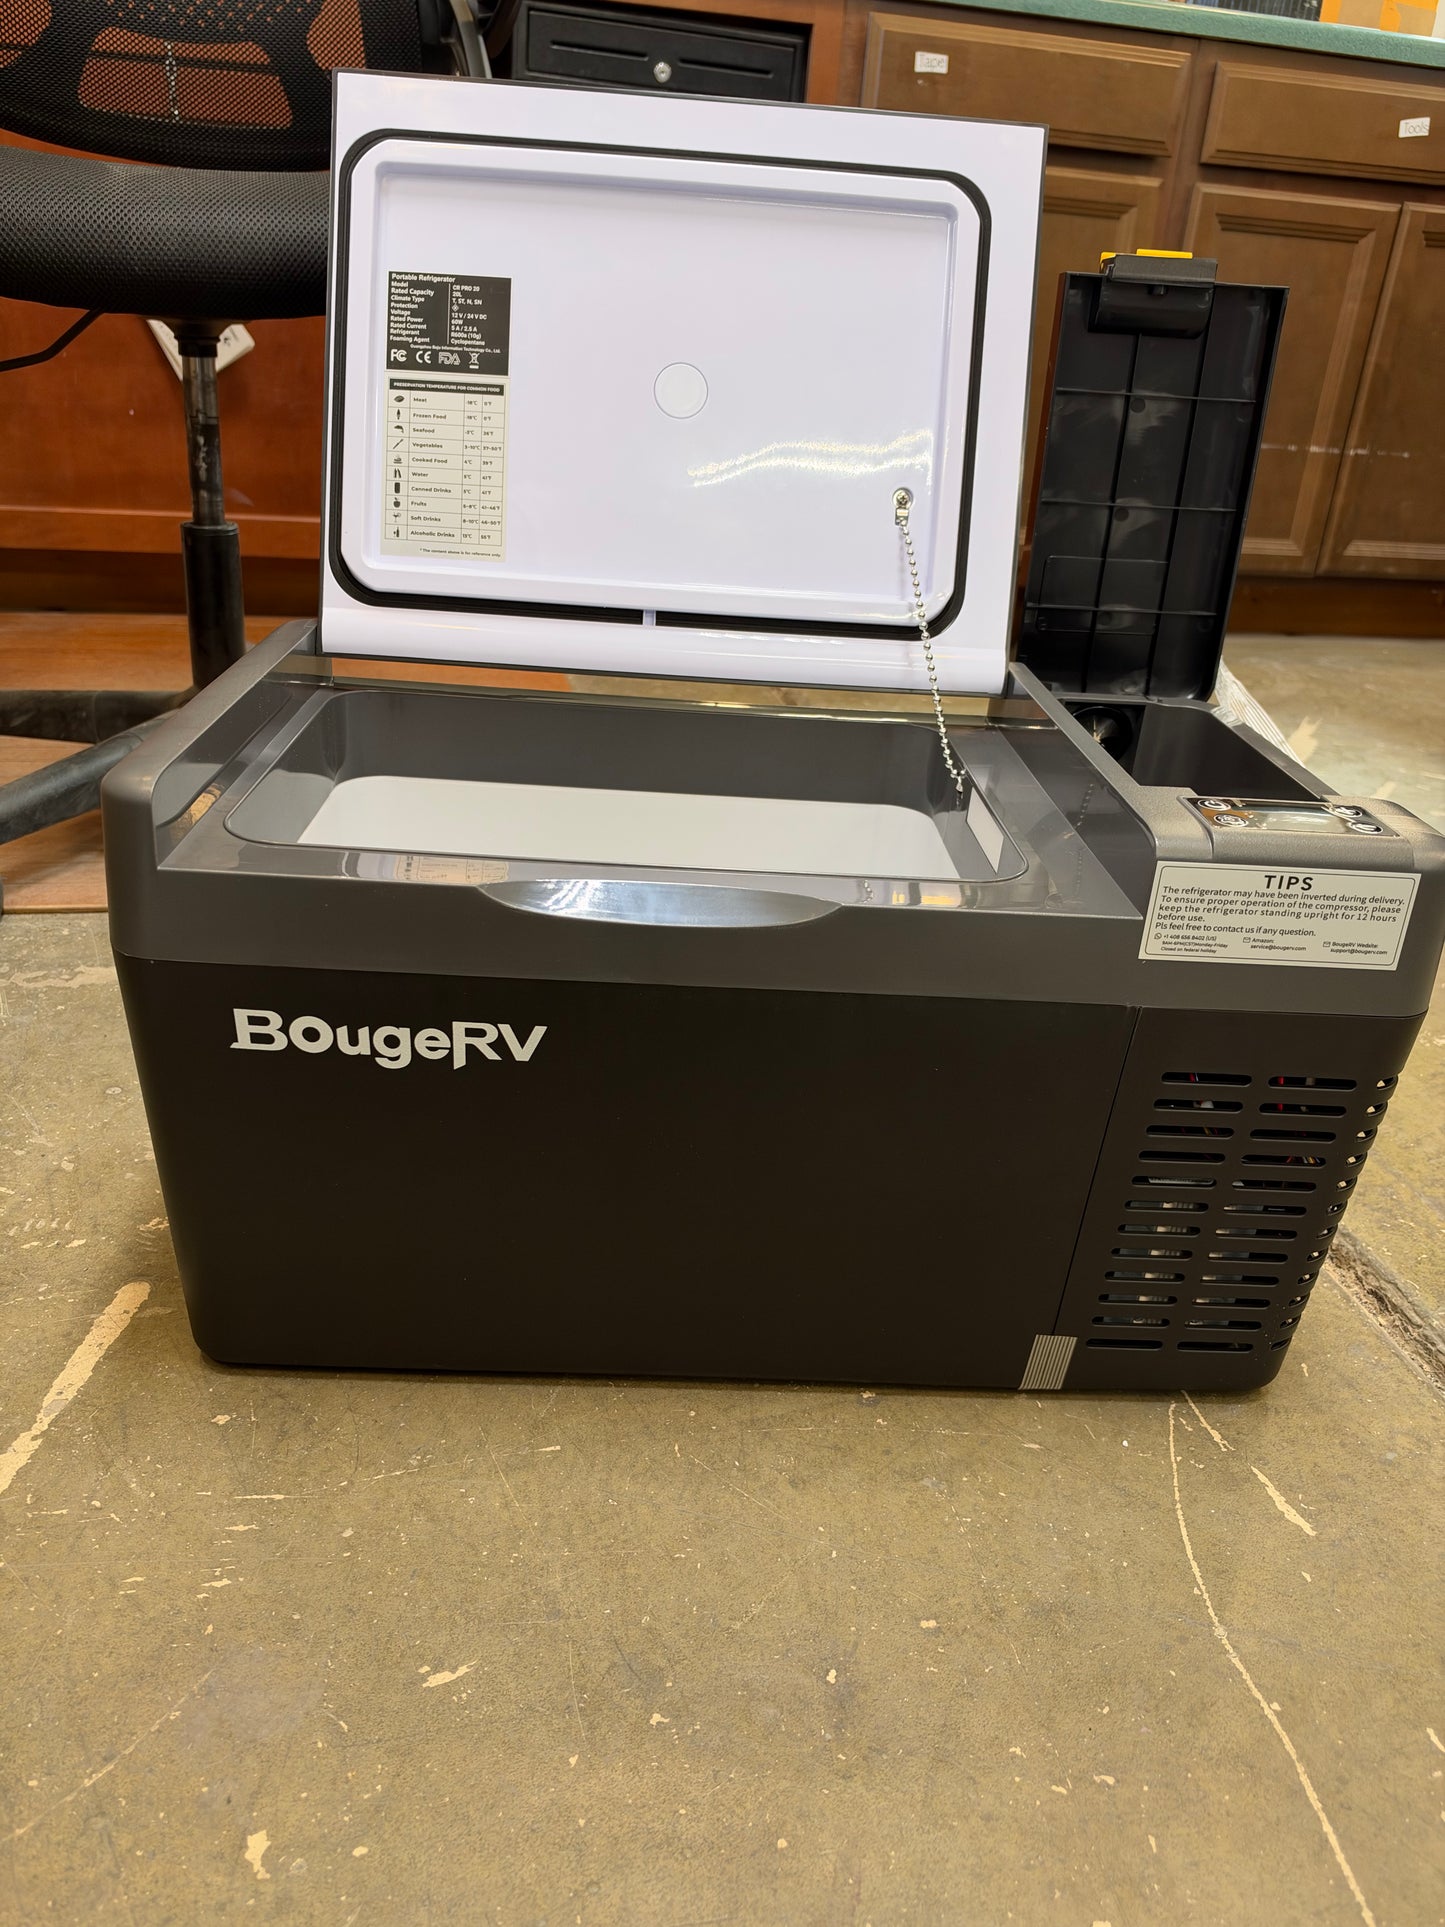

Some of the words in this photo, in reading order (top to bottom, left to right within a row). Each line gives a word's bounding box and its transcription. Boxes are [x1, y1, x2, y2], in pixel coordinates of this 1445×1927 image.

[419, 275, 456, 283] Refrigerator
[1264, 874, 1313, 890] TIPS
[1163, 886, 1179, 894] The
[1181, 887, 1232, 897] refrigerator
[1254, 890, 1275, 898] have
[1277, 891, 1298, 899] been
[1301, 892, 1337, 901] inverted
[1339, 894, 1367, 904] during
[1368, 896, 1405, 906] delivery.
[1159, 904, 1182, 913] keep
[1185, 905, 1200, 913] the
[1202, 906, 1258, 916] refrigerator
[1260, 908, 1301, 919] standing
[1304, 911, 1339, 920] upright
[1370, 914, 1396, 922] hours
[1240, 899, 1285, 908] operation
[1299, 901, 1313, 909] the
[1315, 903, 1369, 913] compressor,
[1372, 905, 1401, 915] please
[1157, 913, 1186, 921] before
[1155, 922, 1168, 930] Pls
[1186, 923, 1202, 931] free
[1279, 928, 1316, 936] question.
[230, 1008, 547, 1070] BougeRV
